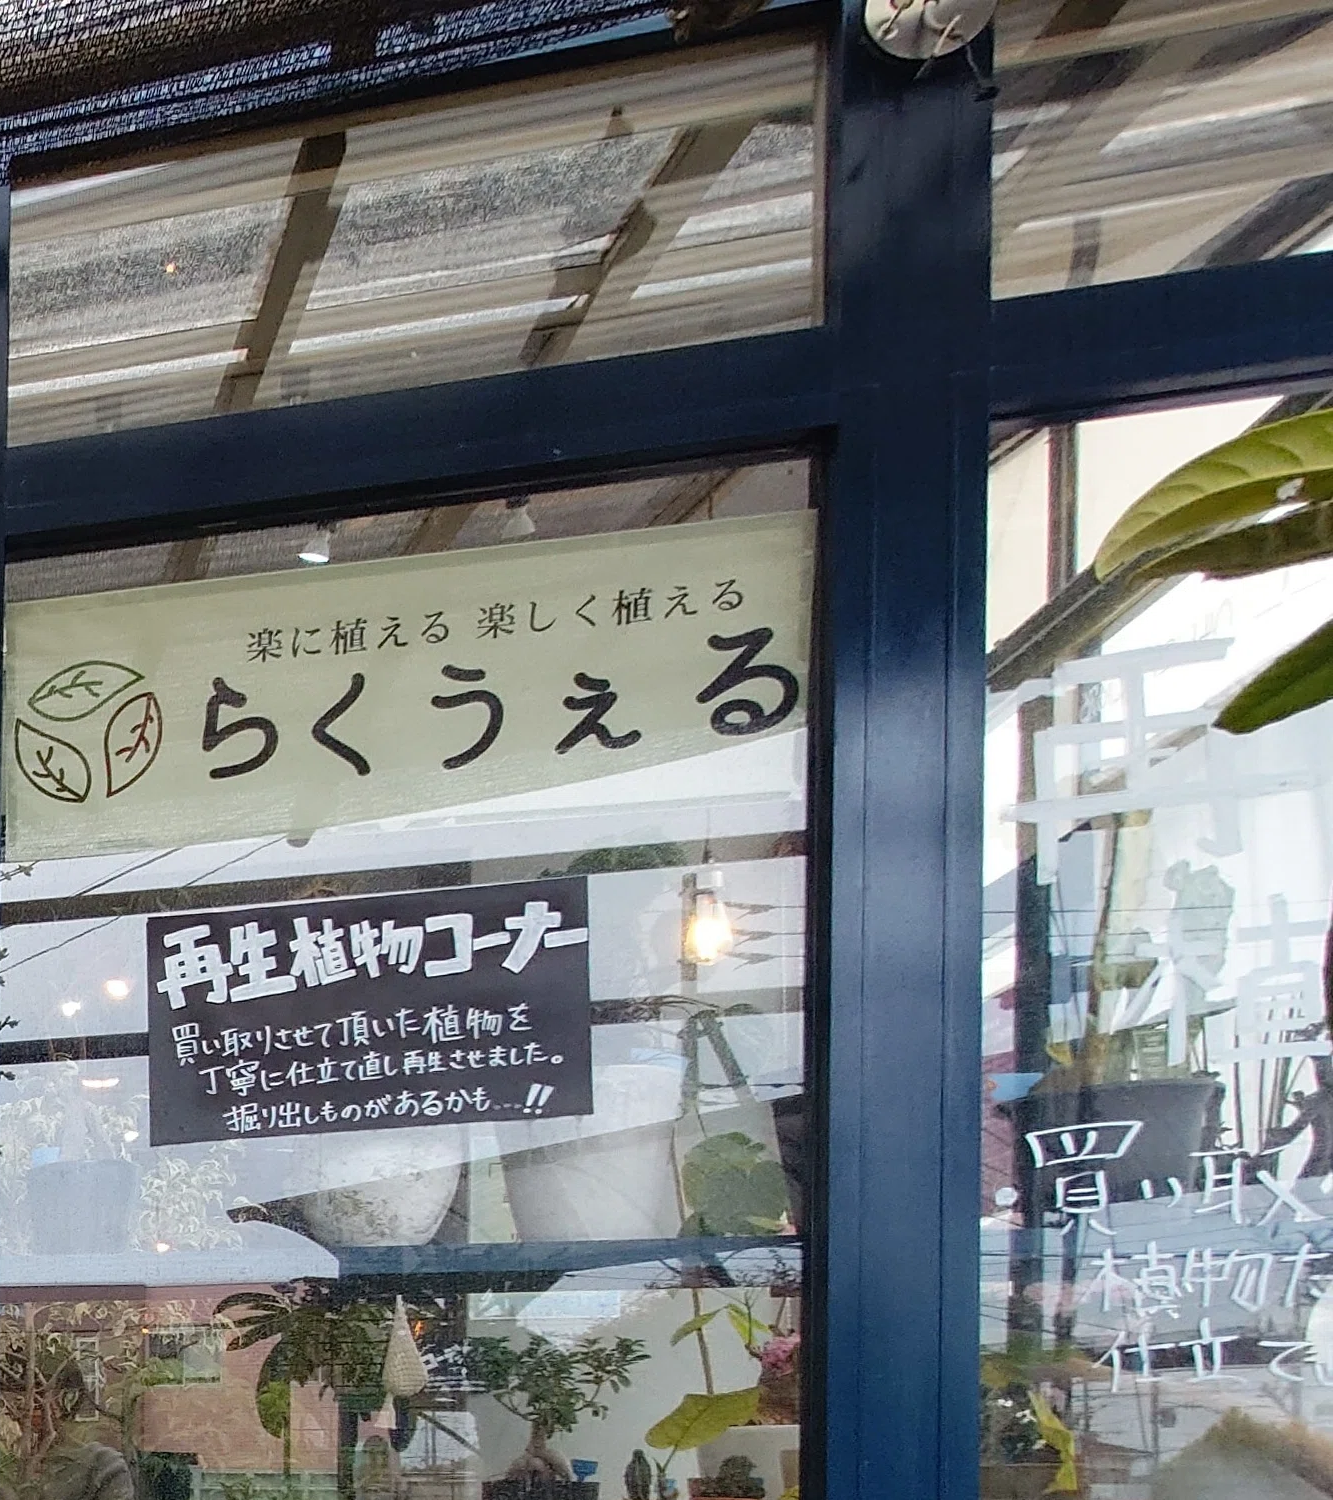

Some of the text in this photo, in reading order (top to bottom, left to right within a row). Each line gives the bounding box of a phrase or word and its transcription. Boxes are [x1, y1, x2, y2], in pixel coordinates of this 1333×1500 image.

[246, 578, 745, 664] 楽に植える 楽しく植える
[156, 899, 590, 1010] 再生植物コーナー
[172, 1002, 532, 1067] 買い取りさせて頂いた植物を
[1025, 1119, 1333, 1238] 買い取
